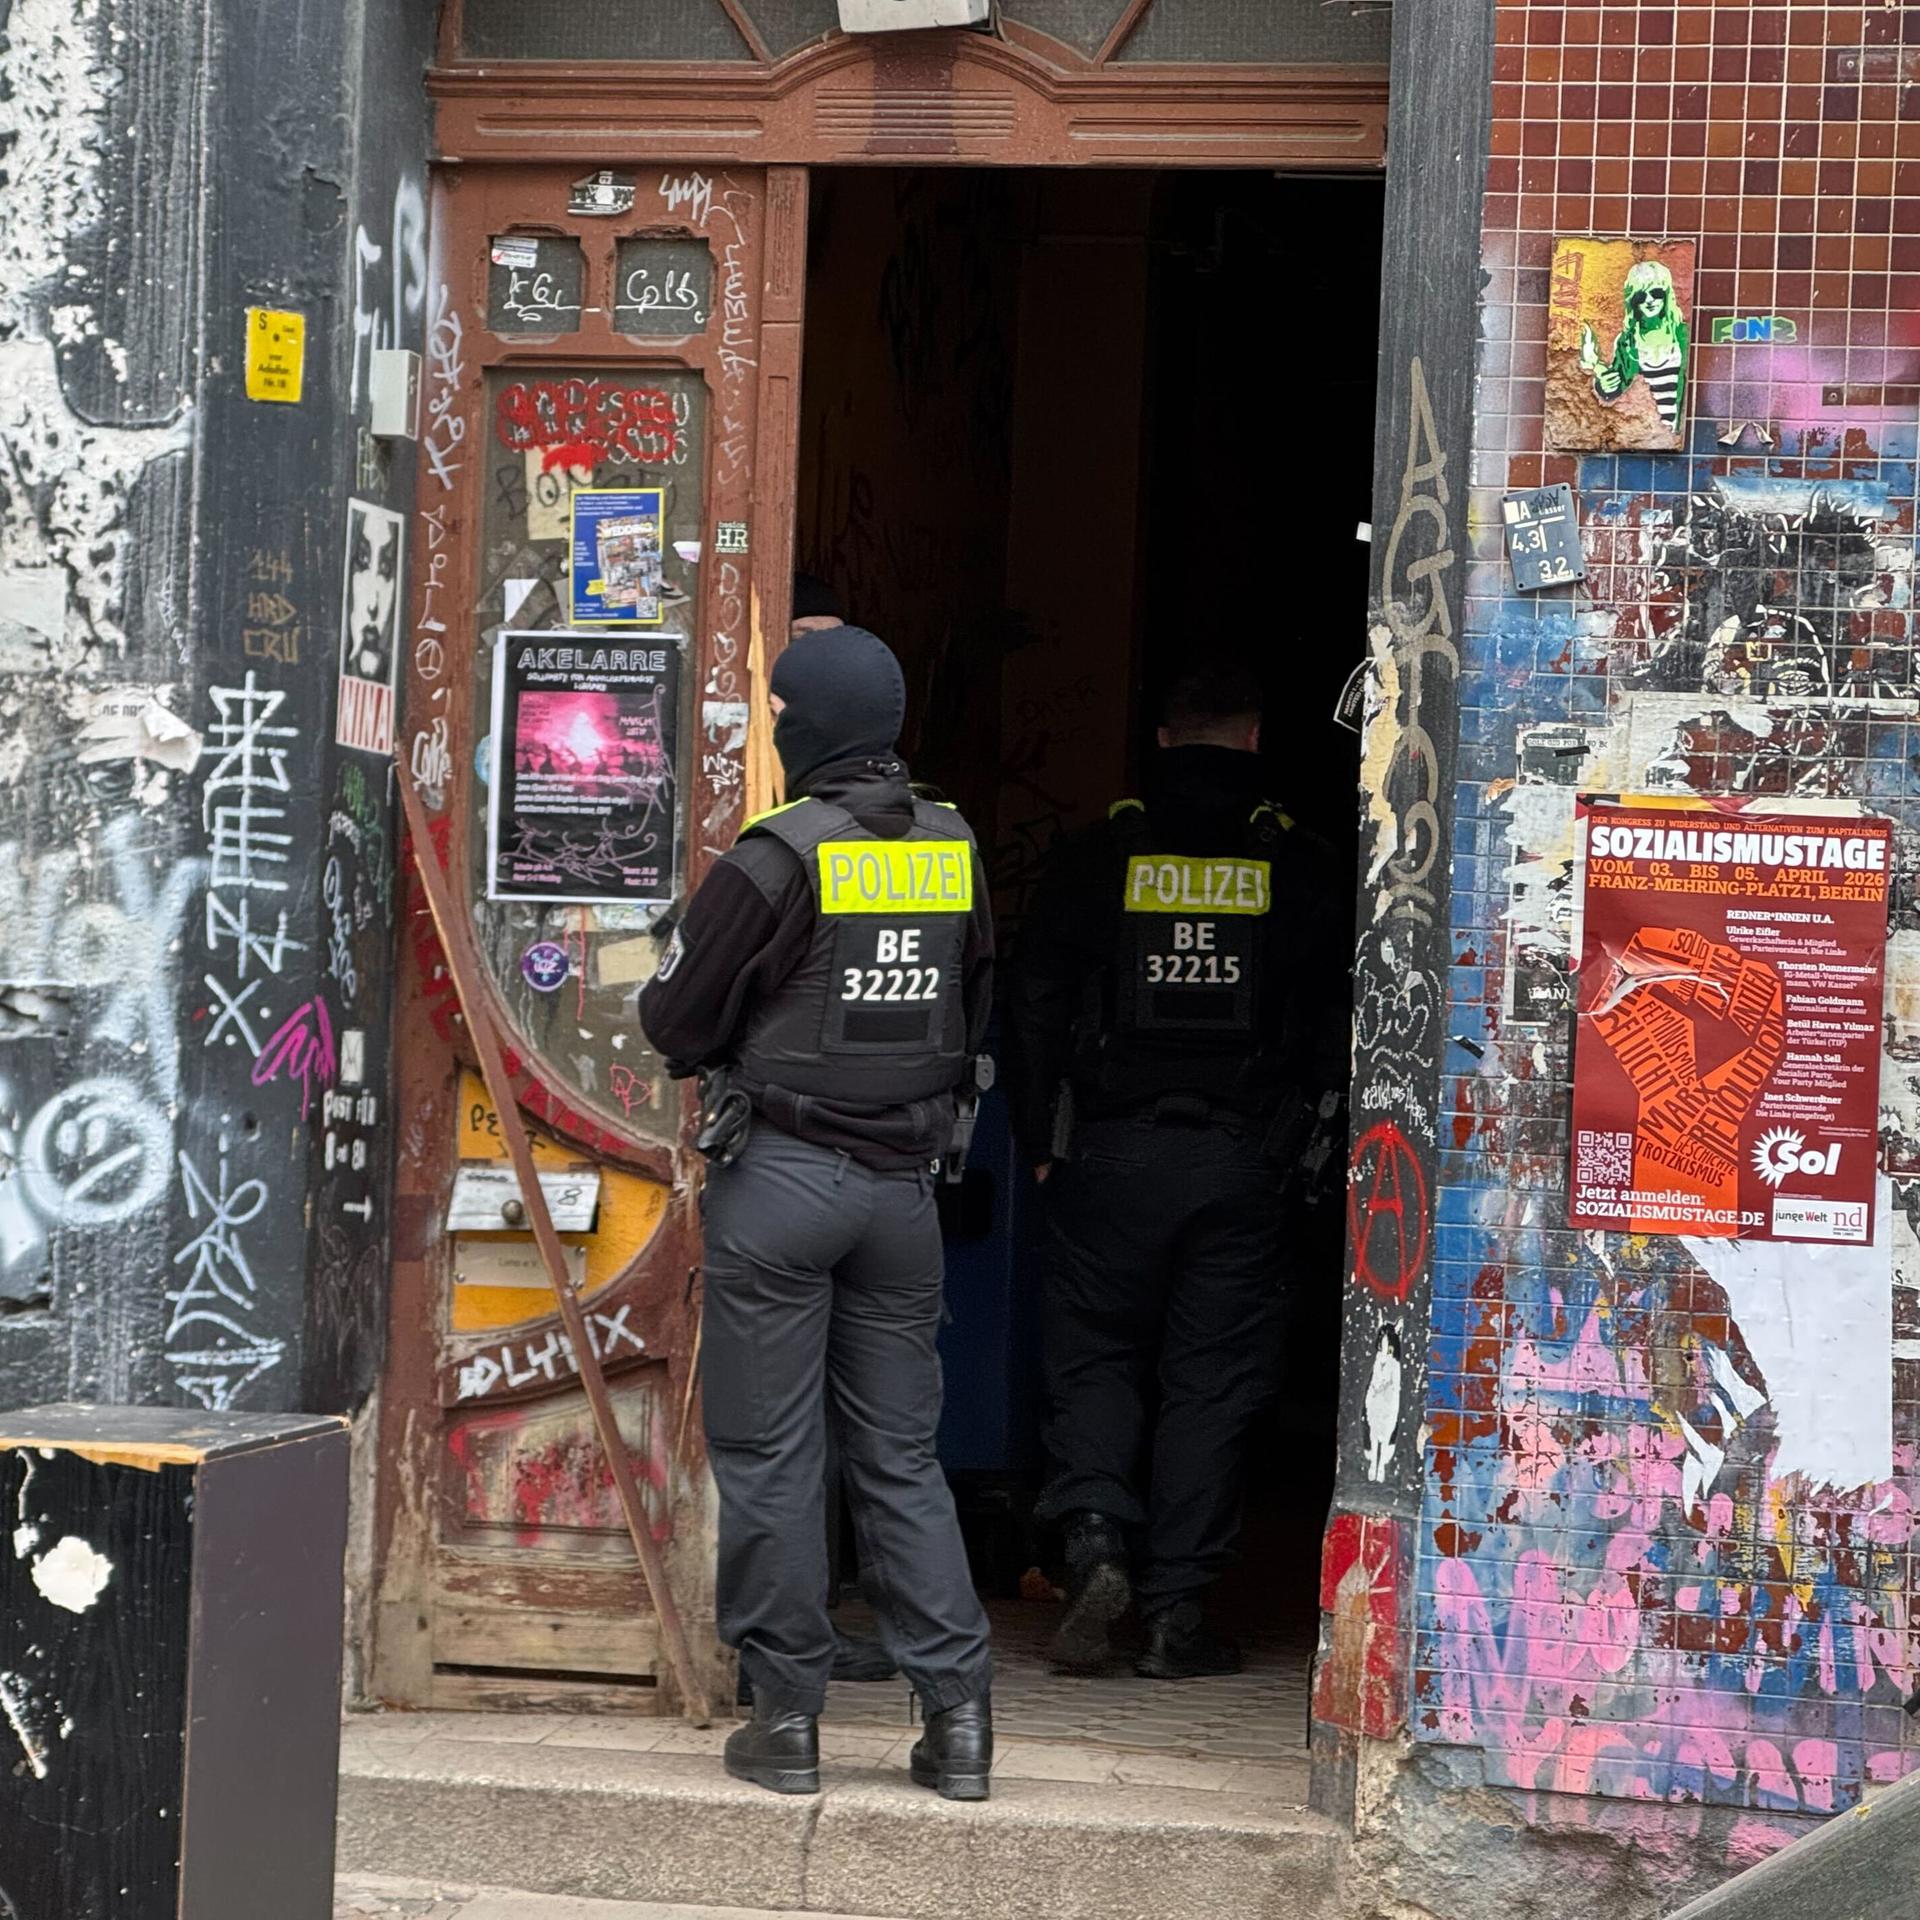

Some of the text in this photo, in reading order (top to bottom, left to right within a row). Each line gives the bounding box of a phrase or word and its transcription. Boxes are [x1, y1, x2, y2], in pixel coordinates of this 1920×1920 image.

[715, 528, 749, 548] HR
[517, 647, 667, 672] AKELARRE
[1592, 816, 1608, 824] DER
[1611, 817, 1652, 826] KONGRESS
[1669, 820, 1720, 830] WIDERSTAND
[1724, 823, 1740, 831] UND
[1743, 824, 1802, 834] ALTERNATIVEN
[1806, 826, 1825, 834] ZUM
[1828, 828, 1887, 837] KAPITALISMUS
[1591, 826, 1886, 870] SOZIALISMUSTAGE
[830, 852, 967, 902] POLIZEI
[1589, 859, 1885, 886] VOM 03. BIS 05. APRIL 2026
[1133, 864, 1264, 908] POLIZEI
[1819, 886, 1885, 902] BERLIN
[1813, 913, 1835, 924] U.A.
[1173, 922, 1216, 950] BE
[1726, 926, 1781, 937] Ulrike Eifler
[1728, 935, 1796, 946] Gewerkschafterin
[1805, 939, 1837, 948] Mitglied
[876, 929, 921, 963] BE
[1825, 948, 1847, 956] Linke
[1147, 955, 1240, 983] 32215
[1777, 961, 1877, 974] Thorsten Donnermeier
[841, 967, 940, 1001] 32222
[1731, 964, 1780, 1034] ANTIFA
[1785, 994, 1864, 1006] Fabian Goldmann
[1789, 1004, 1867, 1015] Journalist und Autor
[1786, 1019, 1810, 1029] Betül
[1811, 1020, 1841, 1030] Havva
[1637, 1000, 1696, 1086] FEMINISMUS
[1787, 1036, 1801, 1044] der
[1786, 1052, 1841, 1063] Hannah Sell
[1776, 1069, 1810, 1078] Socialist
[1852, 1064, 1865, 1073] der
[1688, 1008, 1785, 1166] REVOLUTION
[1772, 1077, 1847, 1089] Your Party Mitglied
[1764, 1092, 1843, 1104] Ines Schwerdtner
[1636, 1078, 1720, 1150] MARX
[1755, 1109, 1835, 1122] Die Linke (angefragt)
[1635, 1135, 1728, 1189] TROTZKISMUS
[1672, 1132, 1738, 1177] GESCHICHTE
[1773, 1141, 1842, 1175] Sol
[1576, 1184, 1706, 1206] Jetzt anmelden:
[1575, 1201, 1765, 1227] SOZIALISMUSTAGE.DE
[1833, 1207, 1863, 1227] nd
